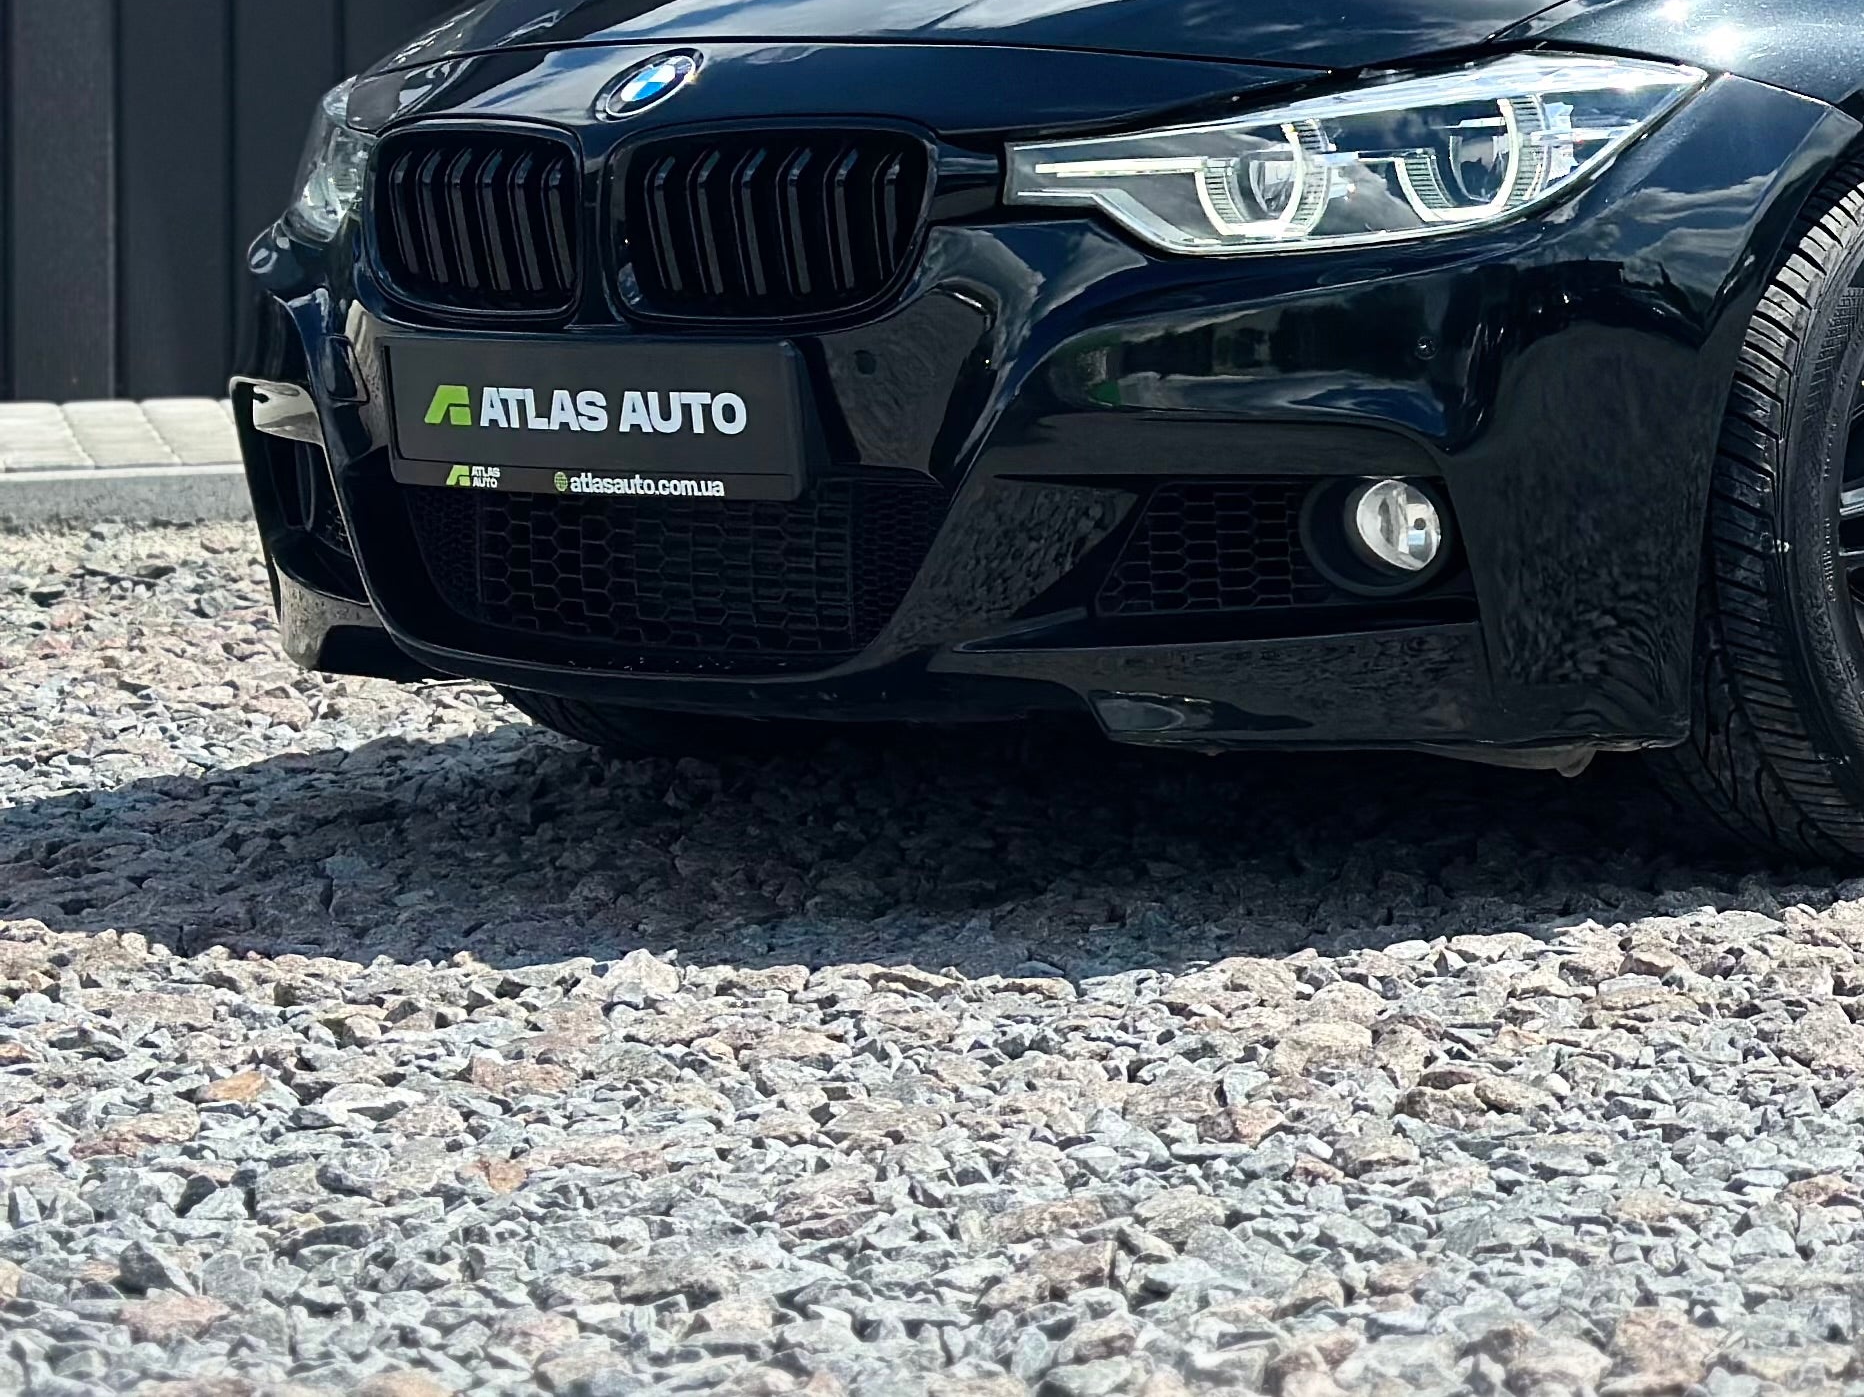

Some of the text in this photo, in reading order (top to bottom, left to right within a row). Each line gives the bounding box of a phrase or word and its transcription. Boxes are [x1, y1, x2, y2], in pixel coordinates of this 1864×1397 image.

[480, 387, 747, 435] ATLAS AUTO
[471, 466, 500, 477] ATLAS
[472, 477, 498, 489] AUTO
[570, 472, 724, 497] atlasauto.com.ua
